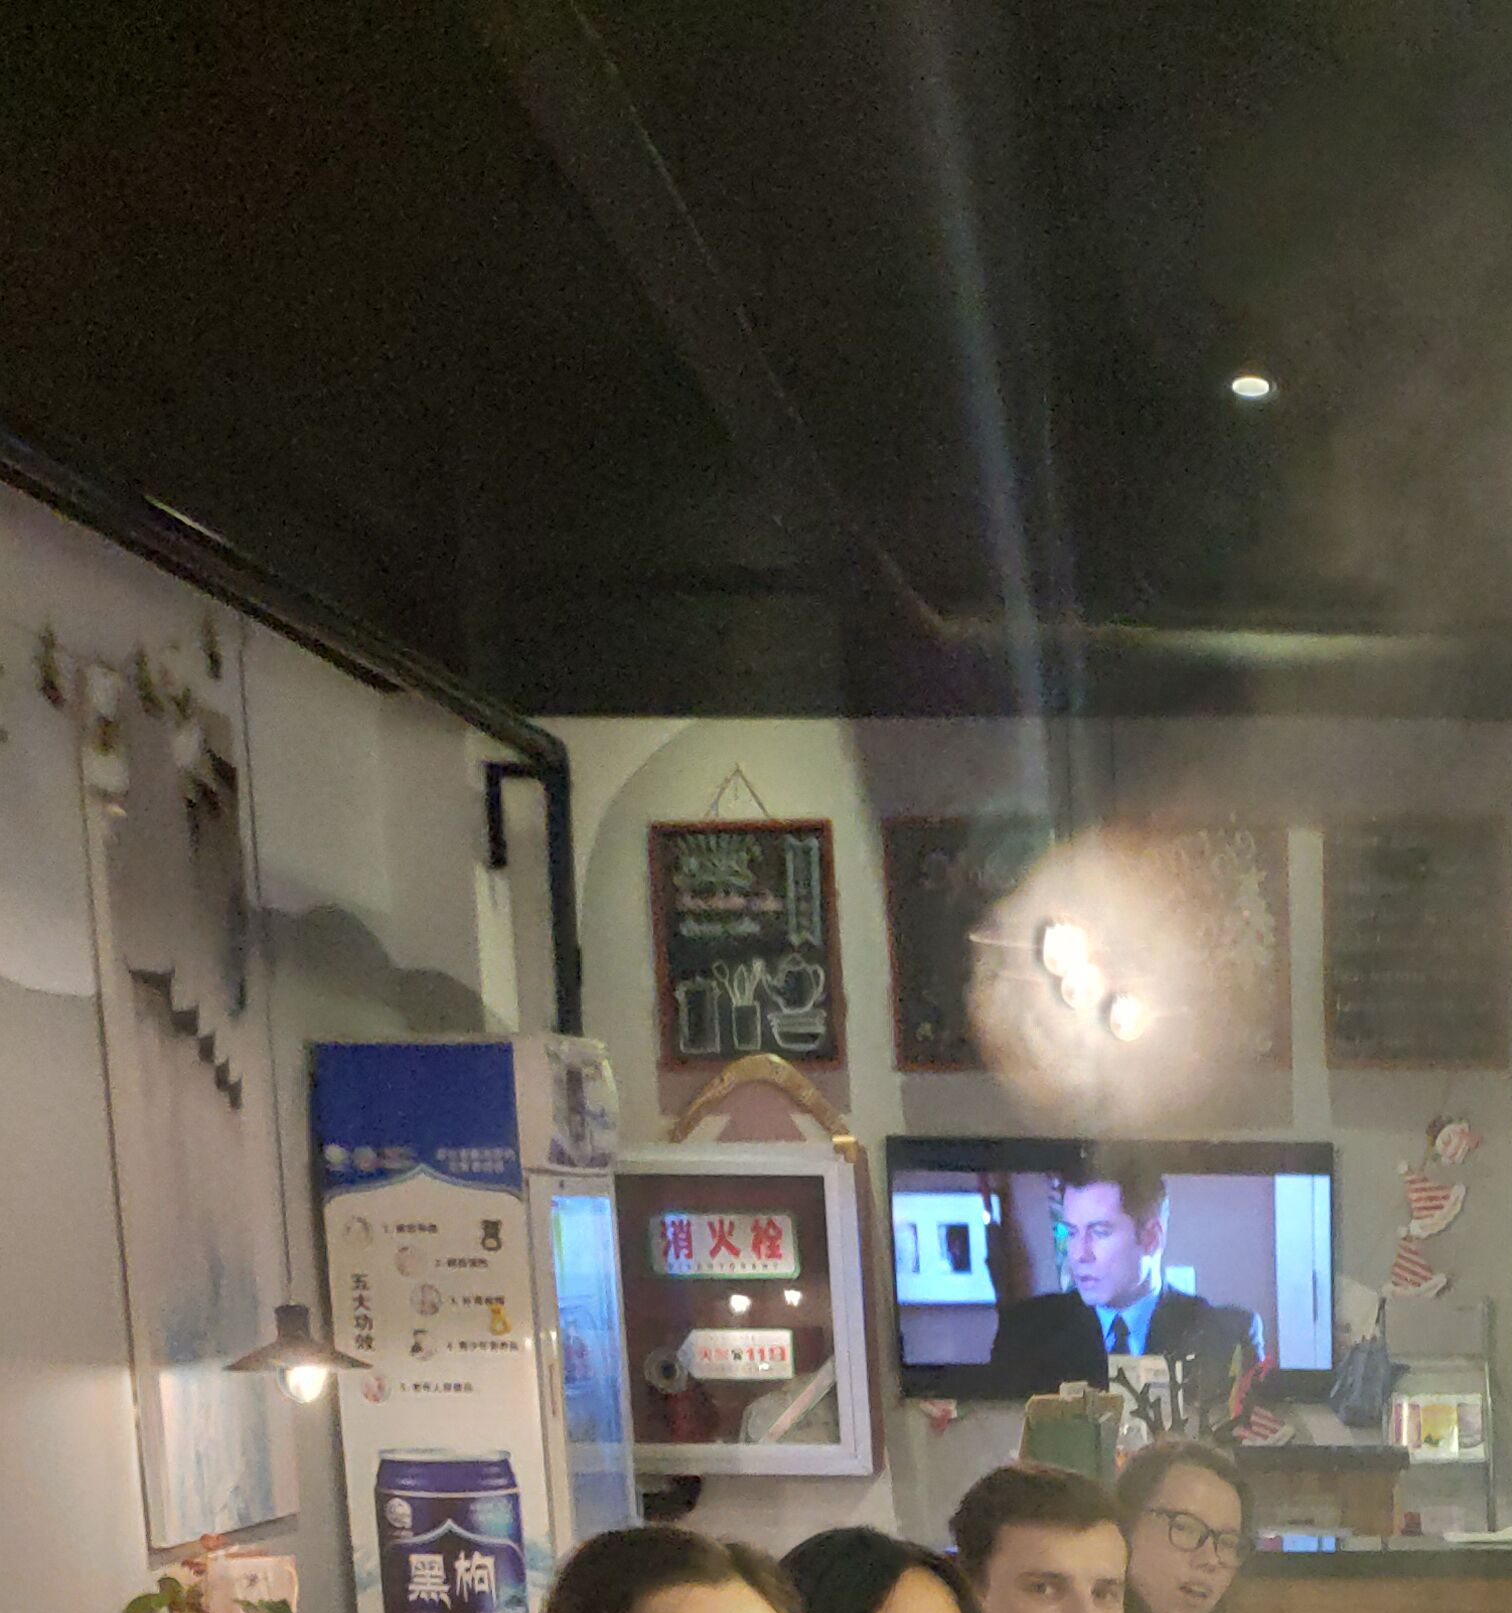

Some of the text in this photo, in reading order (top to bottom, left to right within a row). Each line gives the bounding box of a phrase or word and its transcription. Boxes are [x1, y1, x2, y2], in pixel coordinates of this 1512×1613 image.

[661, 1216, 783, 1260] 消火栓
[351, 1273, 376, 1353] 五大功效
